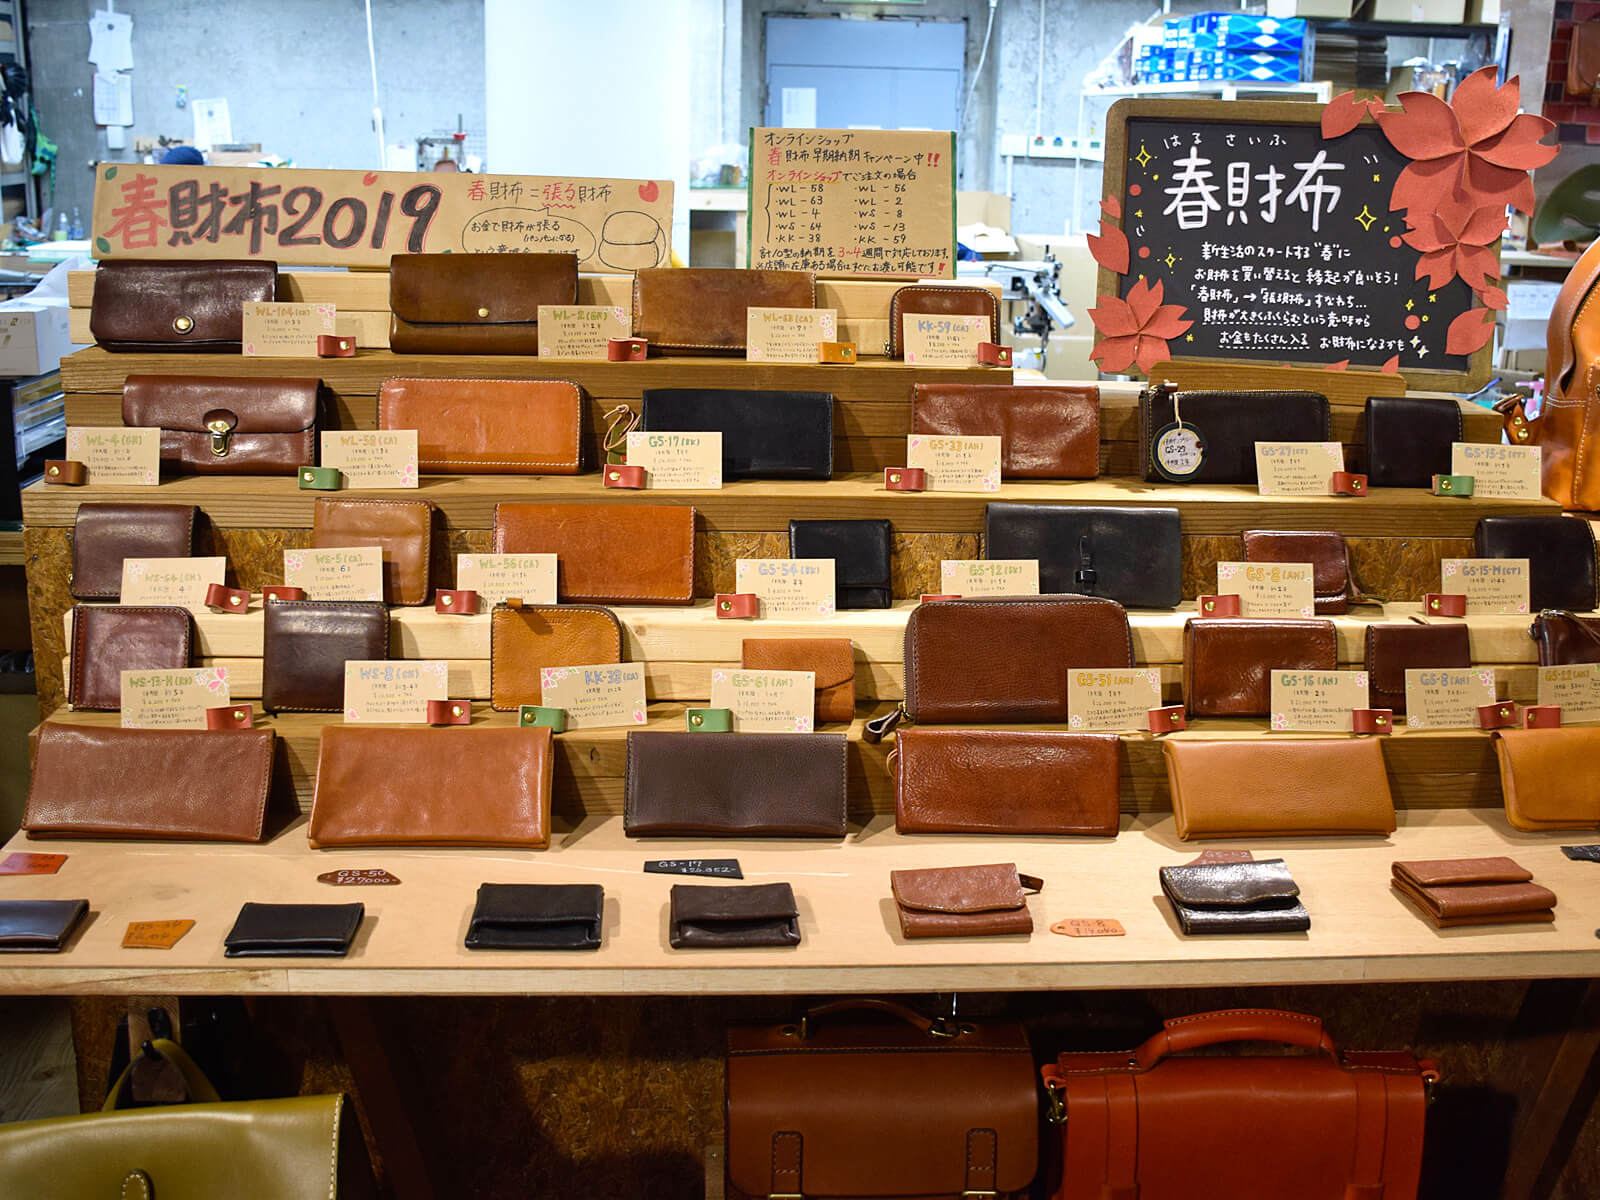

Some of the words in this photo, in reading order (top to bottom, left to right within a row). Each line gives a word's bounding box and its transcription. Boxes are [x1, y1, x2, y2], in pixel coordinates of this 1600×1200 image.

[764, 132, 855, 147] オンラインショップ
[102, 172, 443, 256] 春財布2019
[1162, 145, 1346, 233] 春財布
